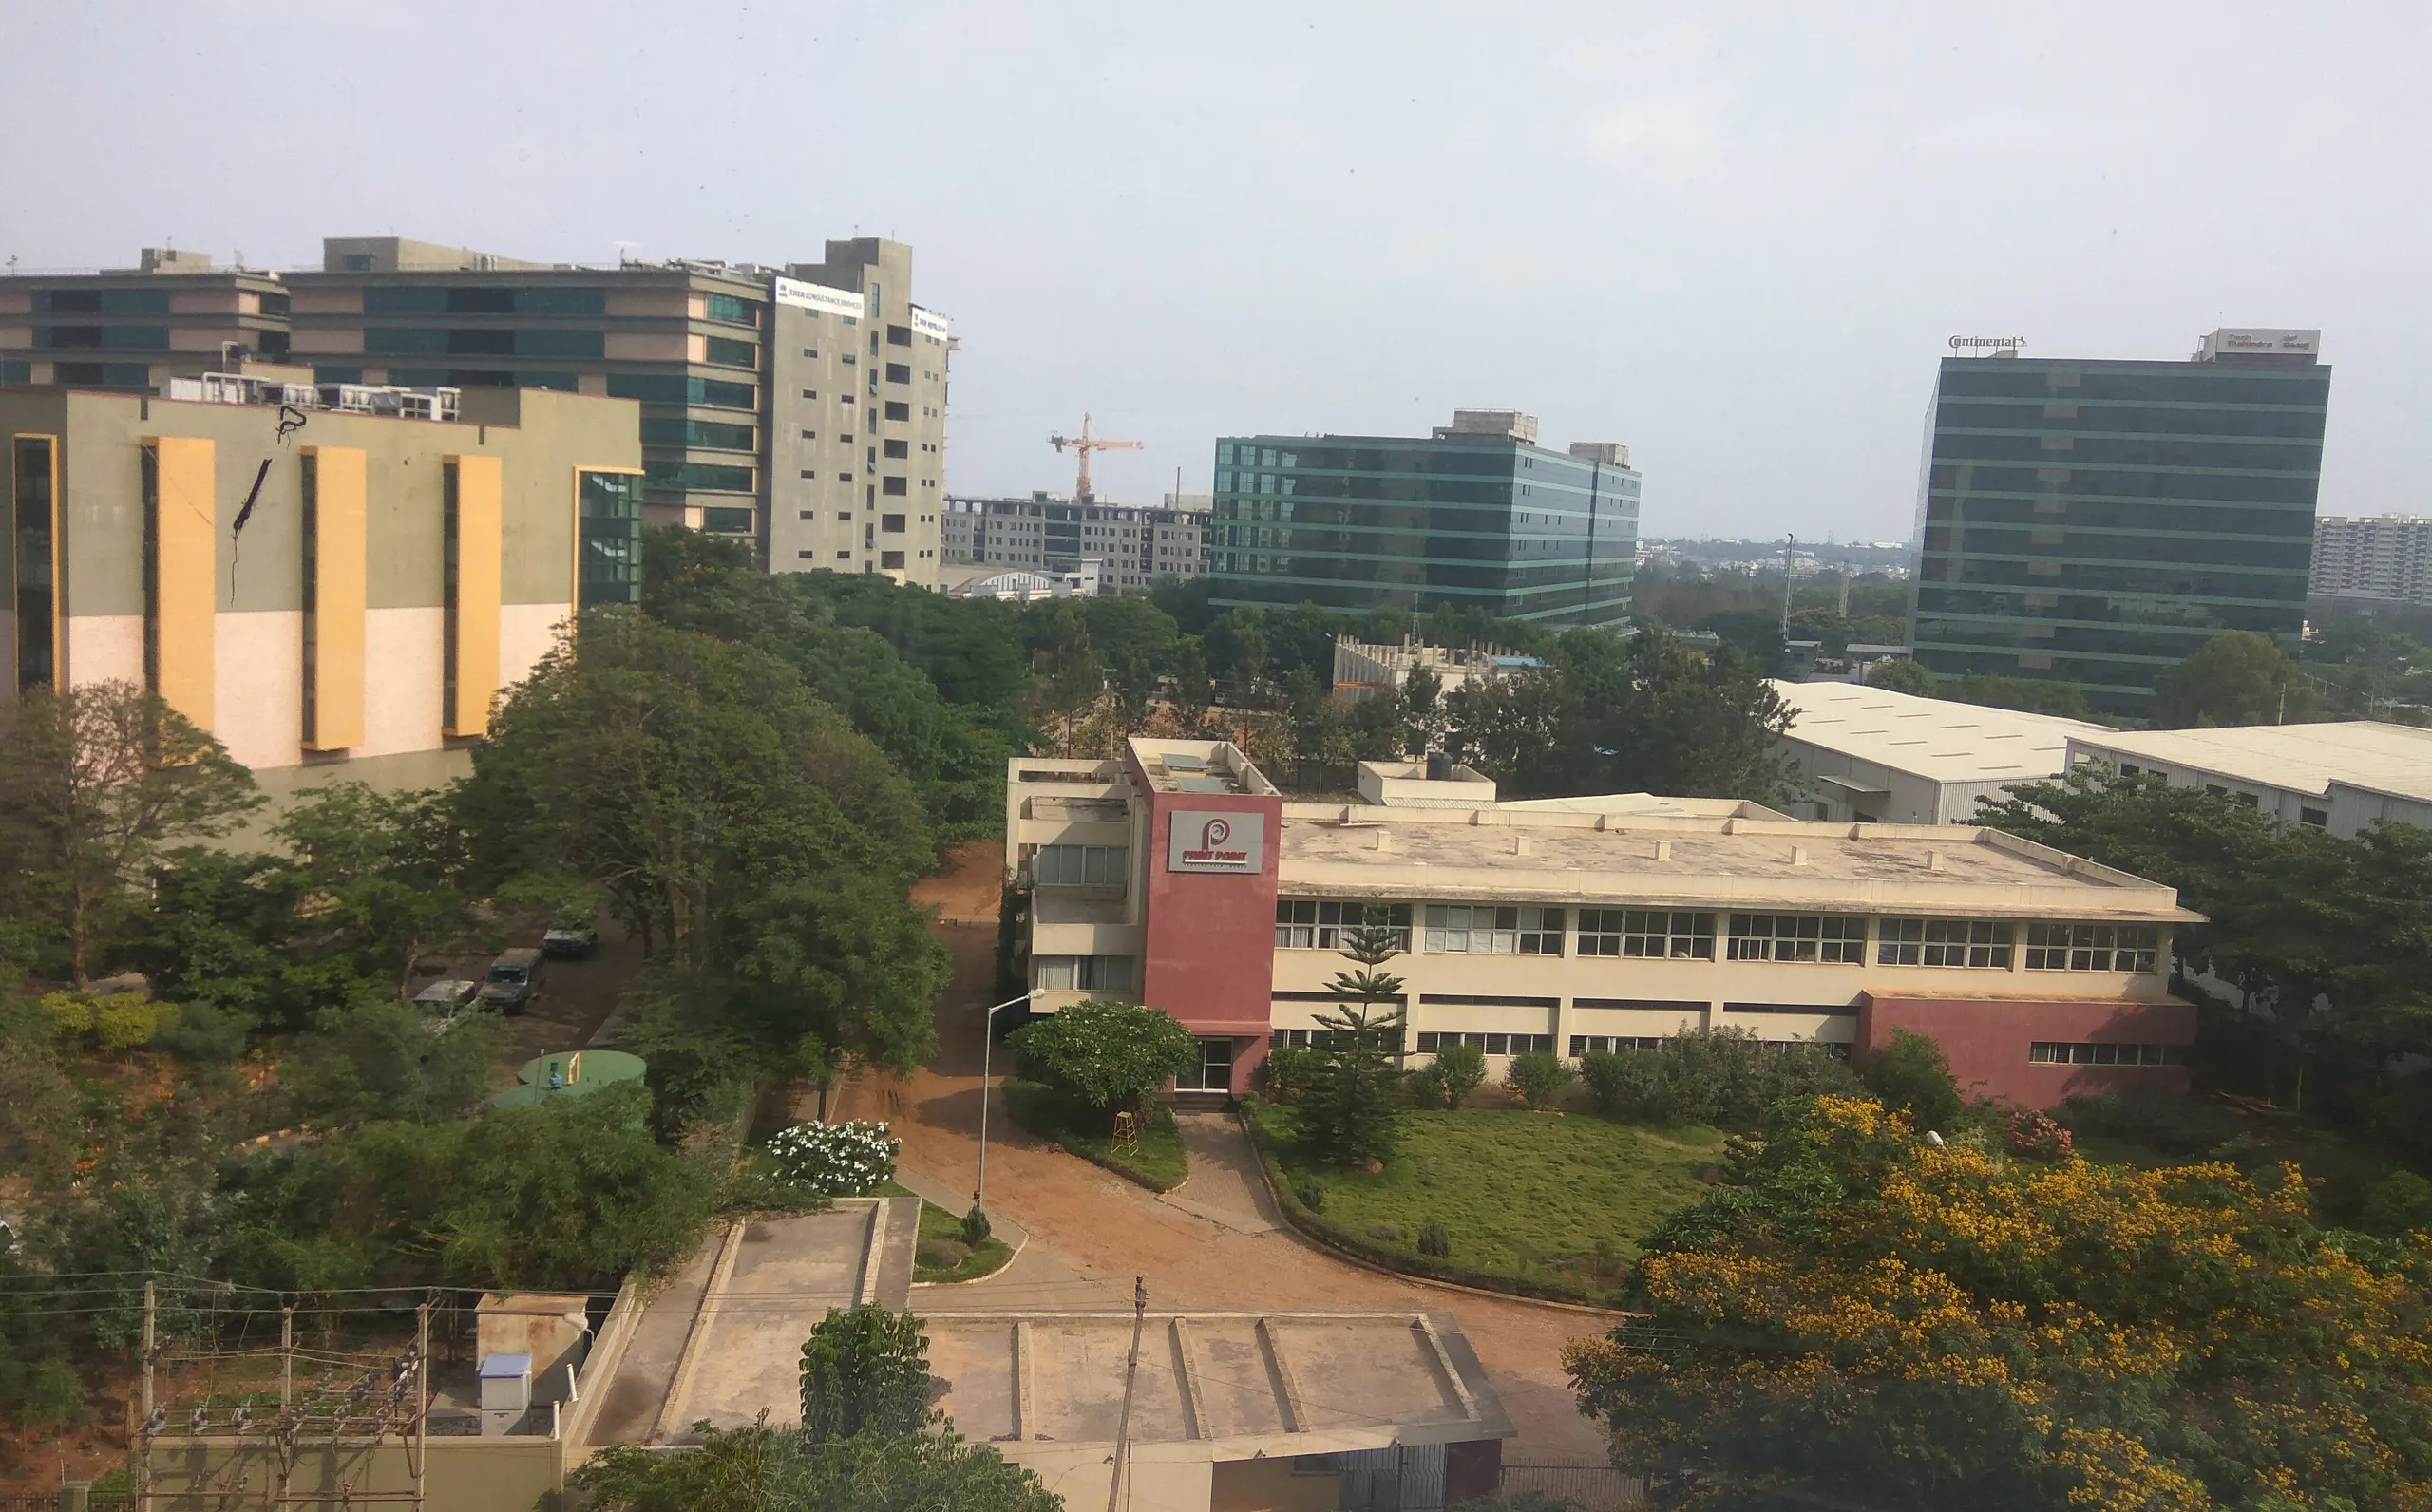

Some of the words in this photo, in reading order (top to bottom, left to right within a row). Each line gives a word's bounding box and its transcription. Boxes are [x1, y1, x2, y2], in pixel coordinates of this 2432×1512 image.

[788, 289, 805, 298] TATA
[1948, 335, 2016, 349] Continental
[1182, 850, 1214, 860] PRINT
[1214, 851, 1247, 861] POINT
